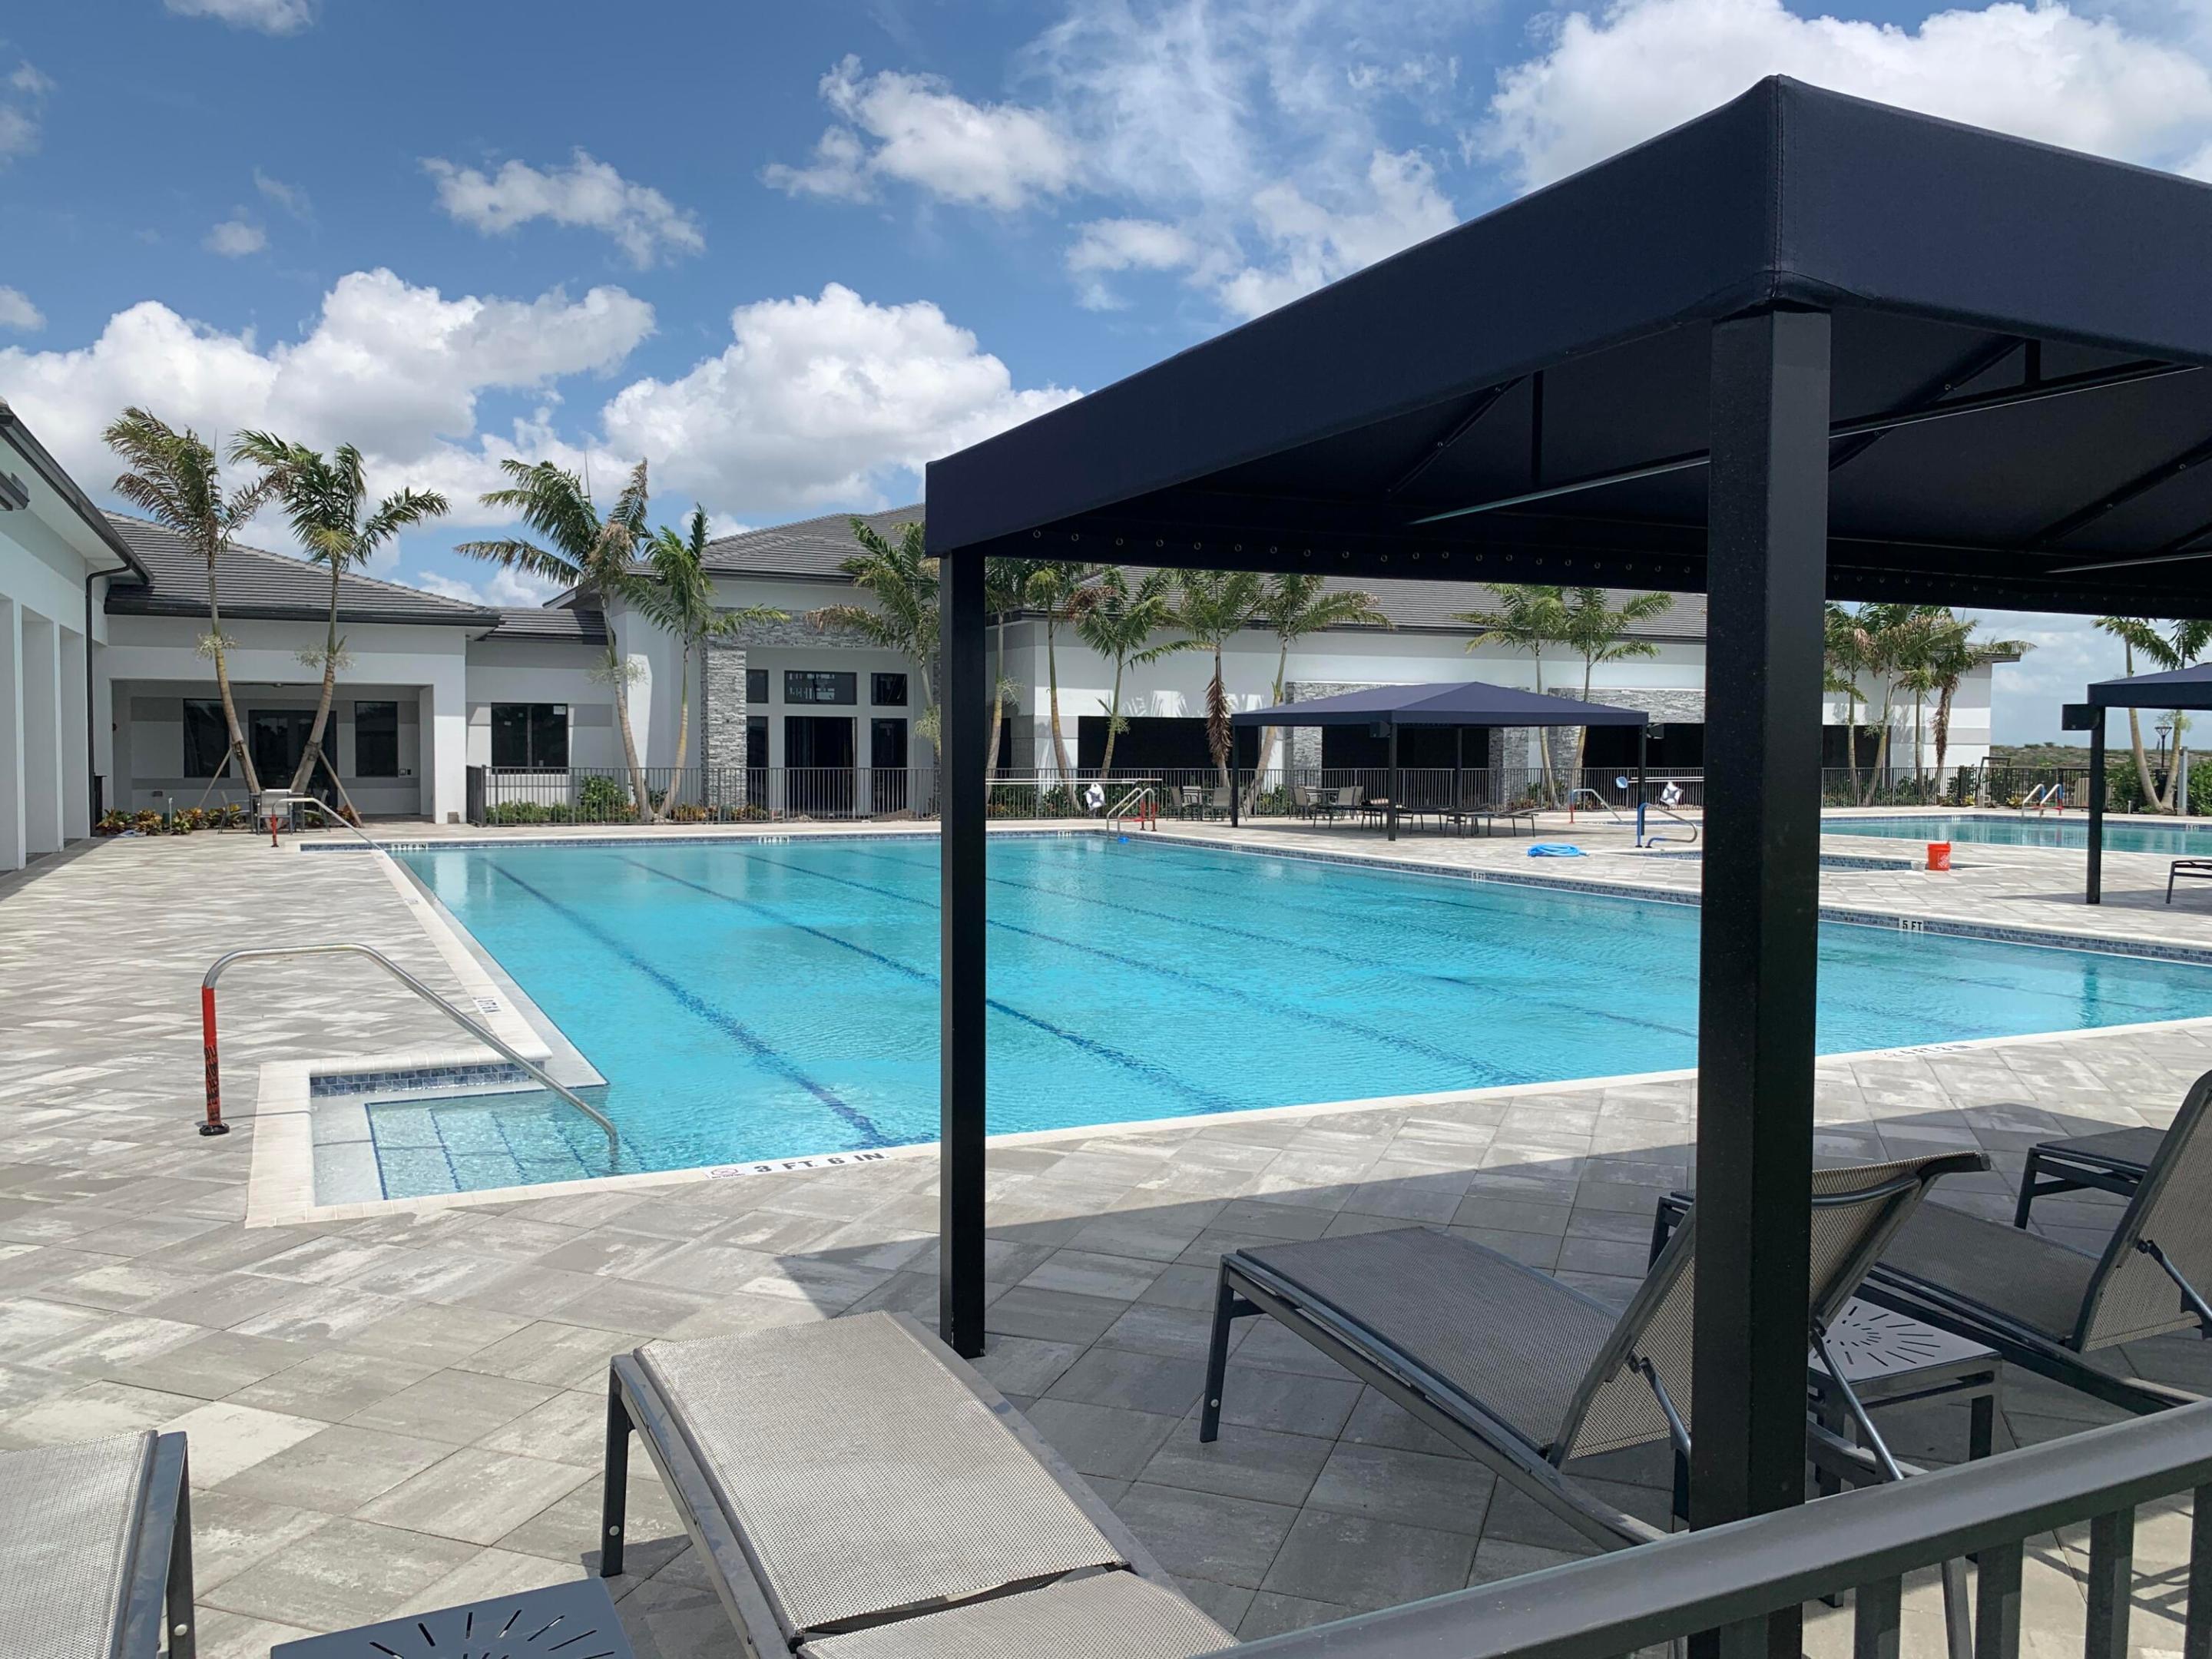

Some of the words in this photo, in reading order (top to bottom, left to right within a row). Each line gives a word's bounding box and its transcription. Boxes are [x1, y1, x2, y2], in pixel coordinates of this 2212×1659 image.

[1902, 920, 1908, 930] 5
[1912, 921, 1922, 931] FT
[782, 1161, 818, 1170] FT.
[853, 1153, 889, 1161] IN.
